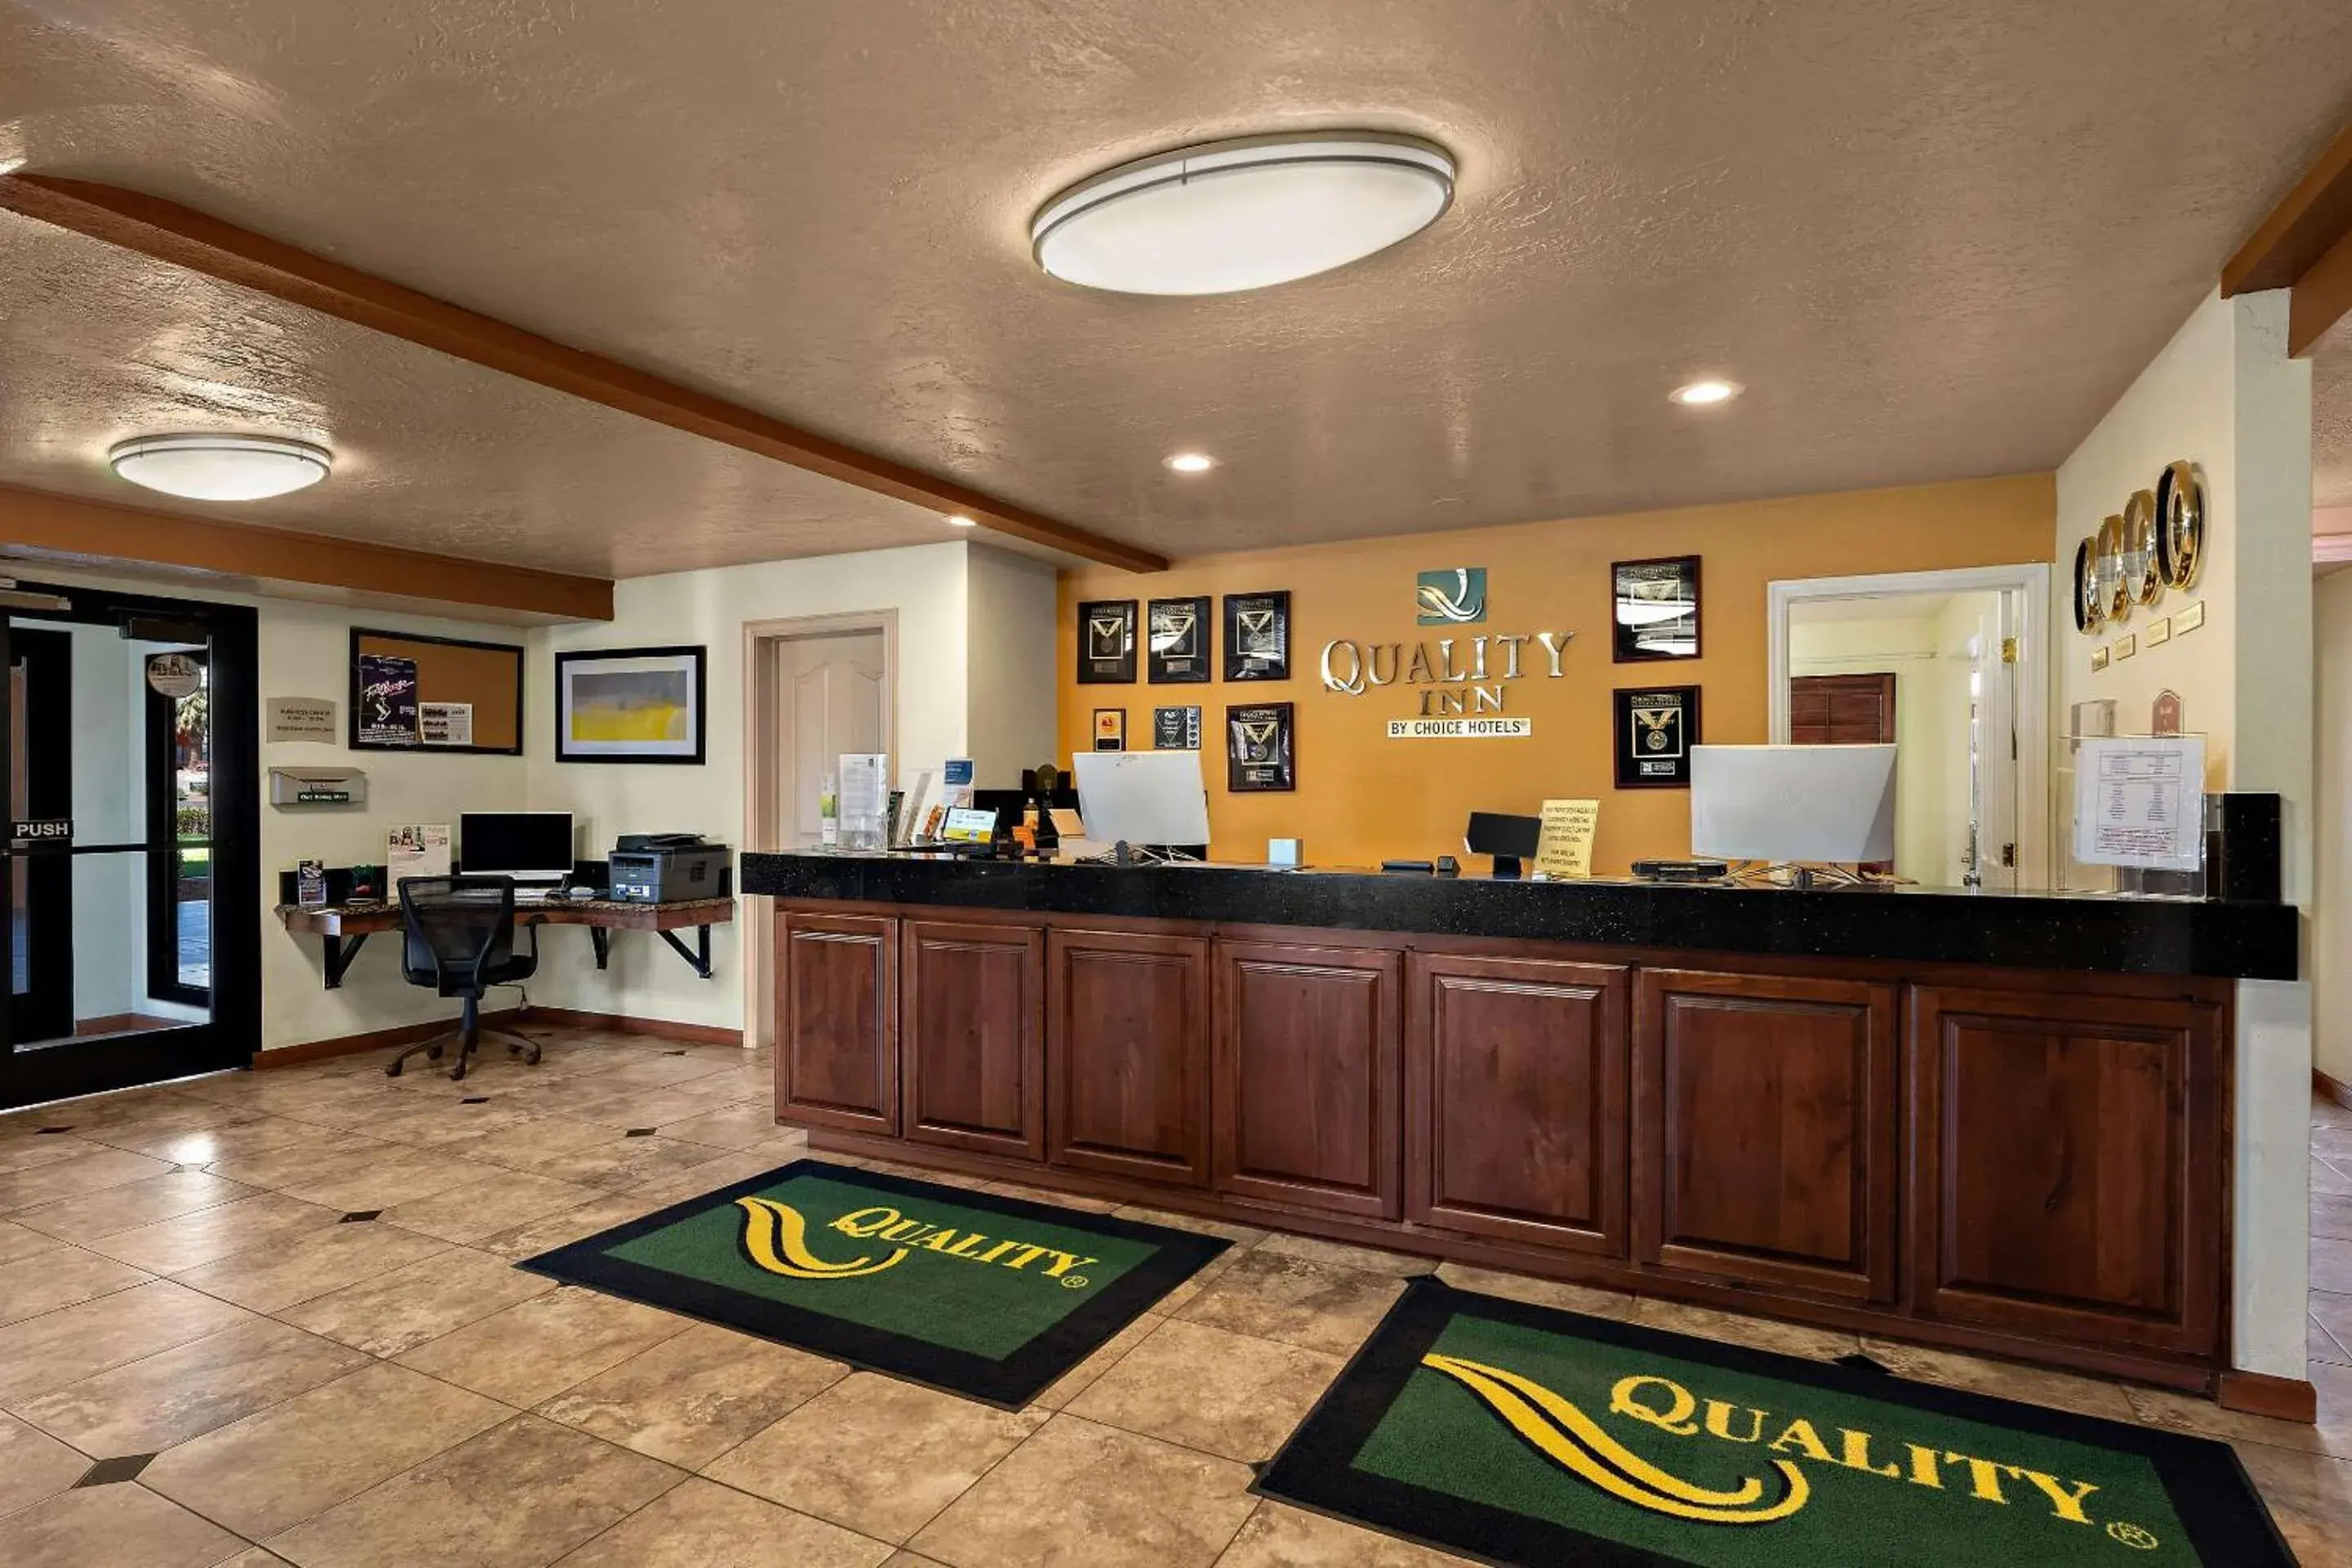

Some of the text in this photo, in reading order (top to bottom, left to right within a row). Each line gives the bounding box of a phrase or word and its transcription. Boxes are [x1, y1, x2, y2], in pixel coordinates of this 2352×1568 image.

[1319, 628, 1576, 696] QUALITY
[1419, 684, 1505, 715] INN
[1391, 722, 1407, 734] BY
[1414, 721, 1463, 734] CHOICE
[16, 822, 69, 837] PUSH
[826, 1206, 1099, 1277] QUALITY
[1610, 1374, 2100, 1525] QUALITY
